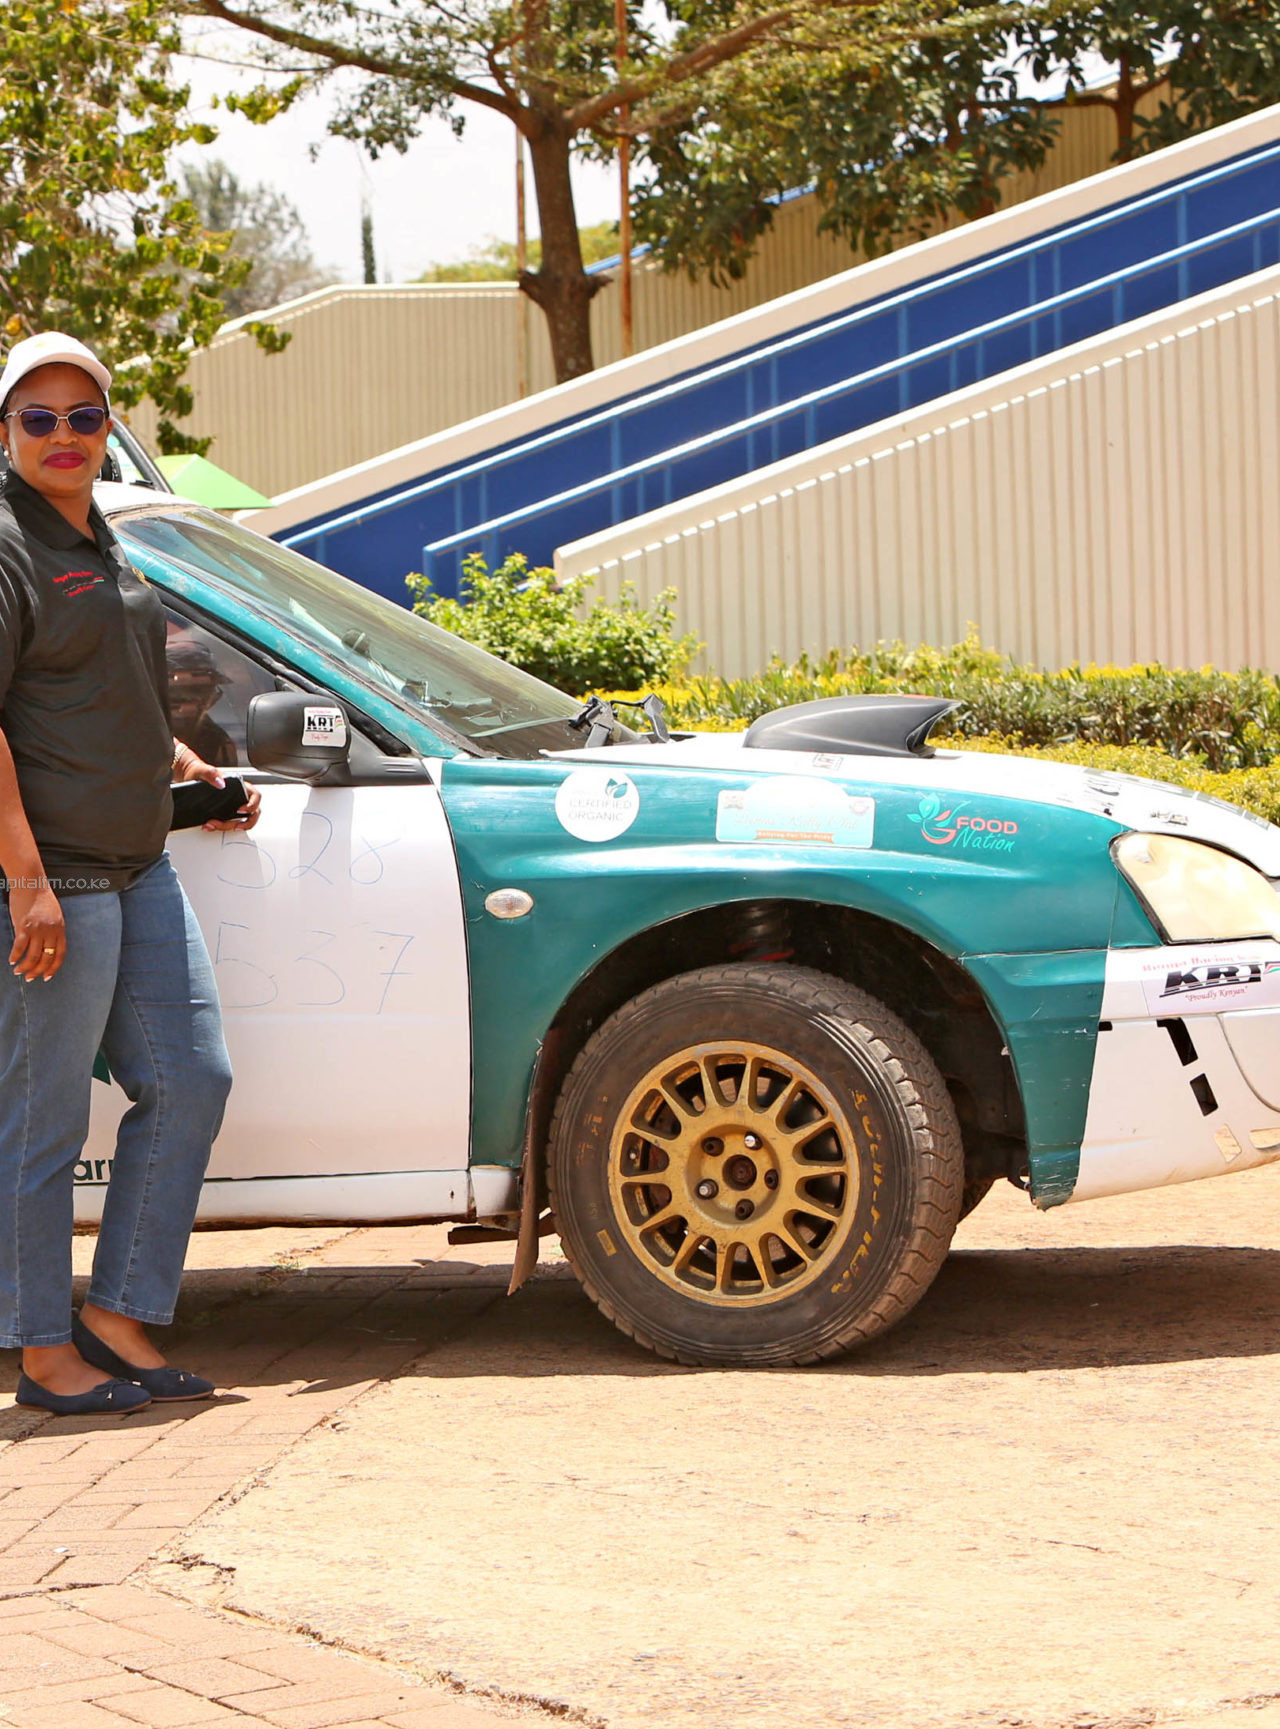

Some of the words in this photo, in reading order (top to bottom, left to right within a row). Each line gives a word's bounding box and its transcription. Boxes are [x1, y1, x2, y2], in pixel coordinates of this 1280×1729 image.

[307, 716, 334, 731] KRT
[569, 799, 632, 809] CERTIFIED
[567, 811, 624, 822] ORGANIC
[956, 816, 1018, 834] FOOD
[953, 826, 1015, 853] Nation
